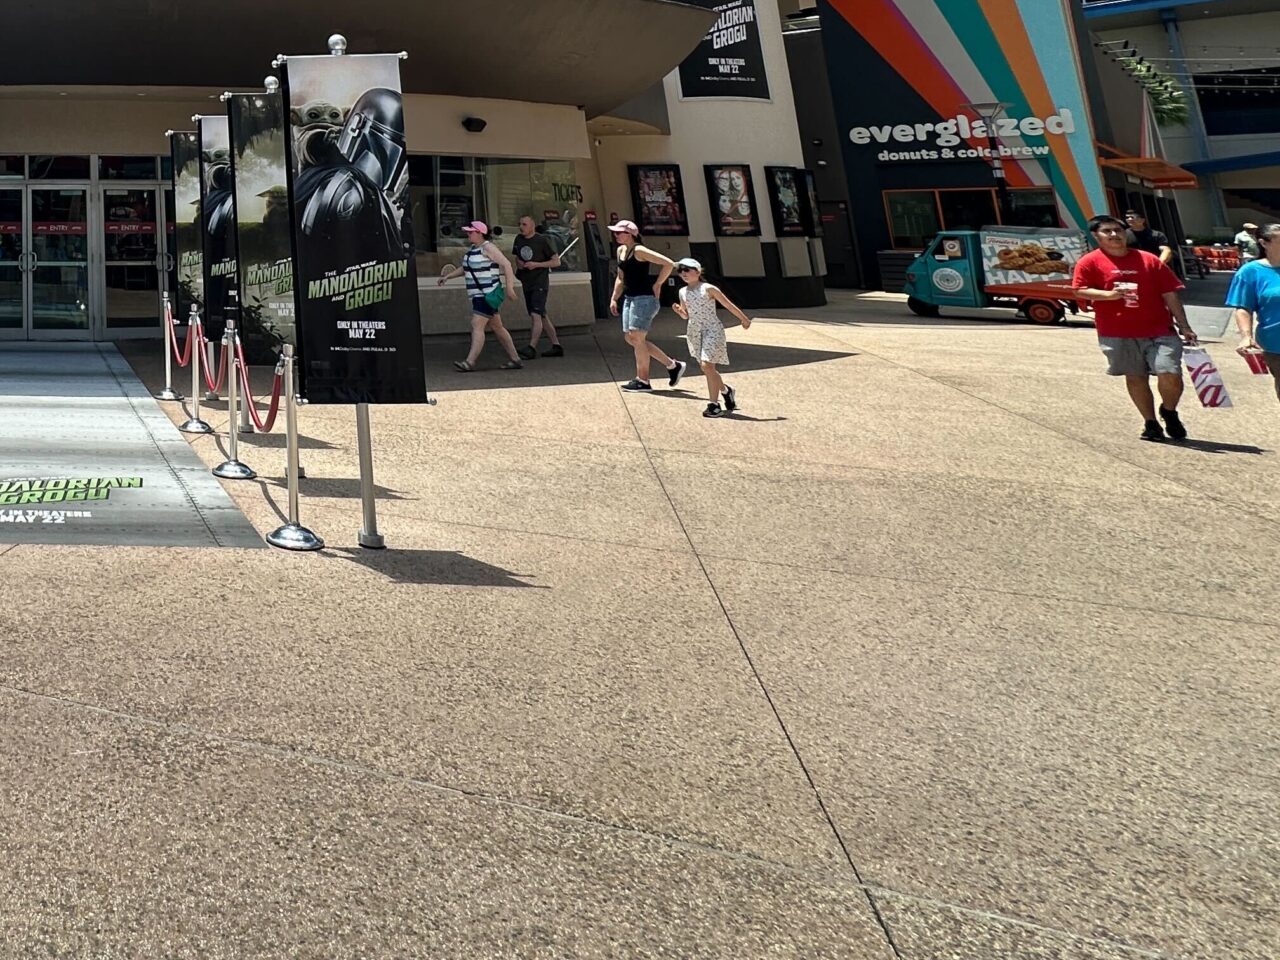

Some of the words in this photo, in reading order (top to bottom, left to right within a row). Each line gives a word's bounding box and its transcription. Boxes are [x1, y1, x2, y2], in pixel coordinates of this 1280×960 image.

[709, 6, 754, 32] ALORIAN
[712, 24, 747, 50] GROGU
[718, 65, 730, 74] MAY
[730, 65, 740, 74] 22
[848, 108, 1075, 147] everglazed
[878, 148, 938, 161] donuts
[941, 148, 956, 159] &
[998, 146, 1050, 158] brew
[552, 182, 584, 203] TICKETS
[50, 224, 69, 232] ENTRY
[120, 224, 140, 232] ENTRY
[344, 264, 360, 272] STAR
[360, 260, 378, 268] WARS
[246, 260, 292, 286] MANDAL
[308, 259, 408, 299] MANDALORIAN
[332, 294, 344, 302] AND
[345, 281, 392, 311] GROGU
[336, 320, 350, 328] ONLY
[351, 320, 358, 328] IN
[358, 321, 386, 329] THEATERS
[348, 328, 364, 338] MAY
[365, 328, 376, 338] 22
[26, 510, 92, 518] THEATERS
[42, 516, 66, 524] 22
